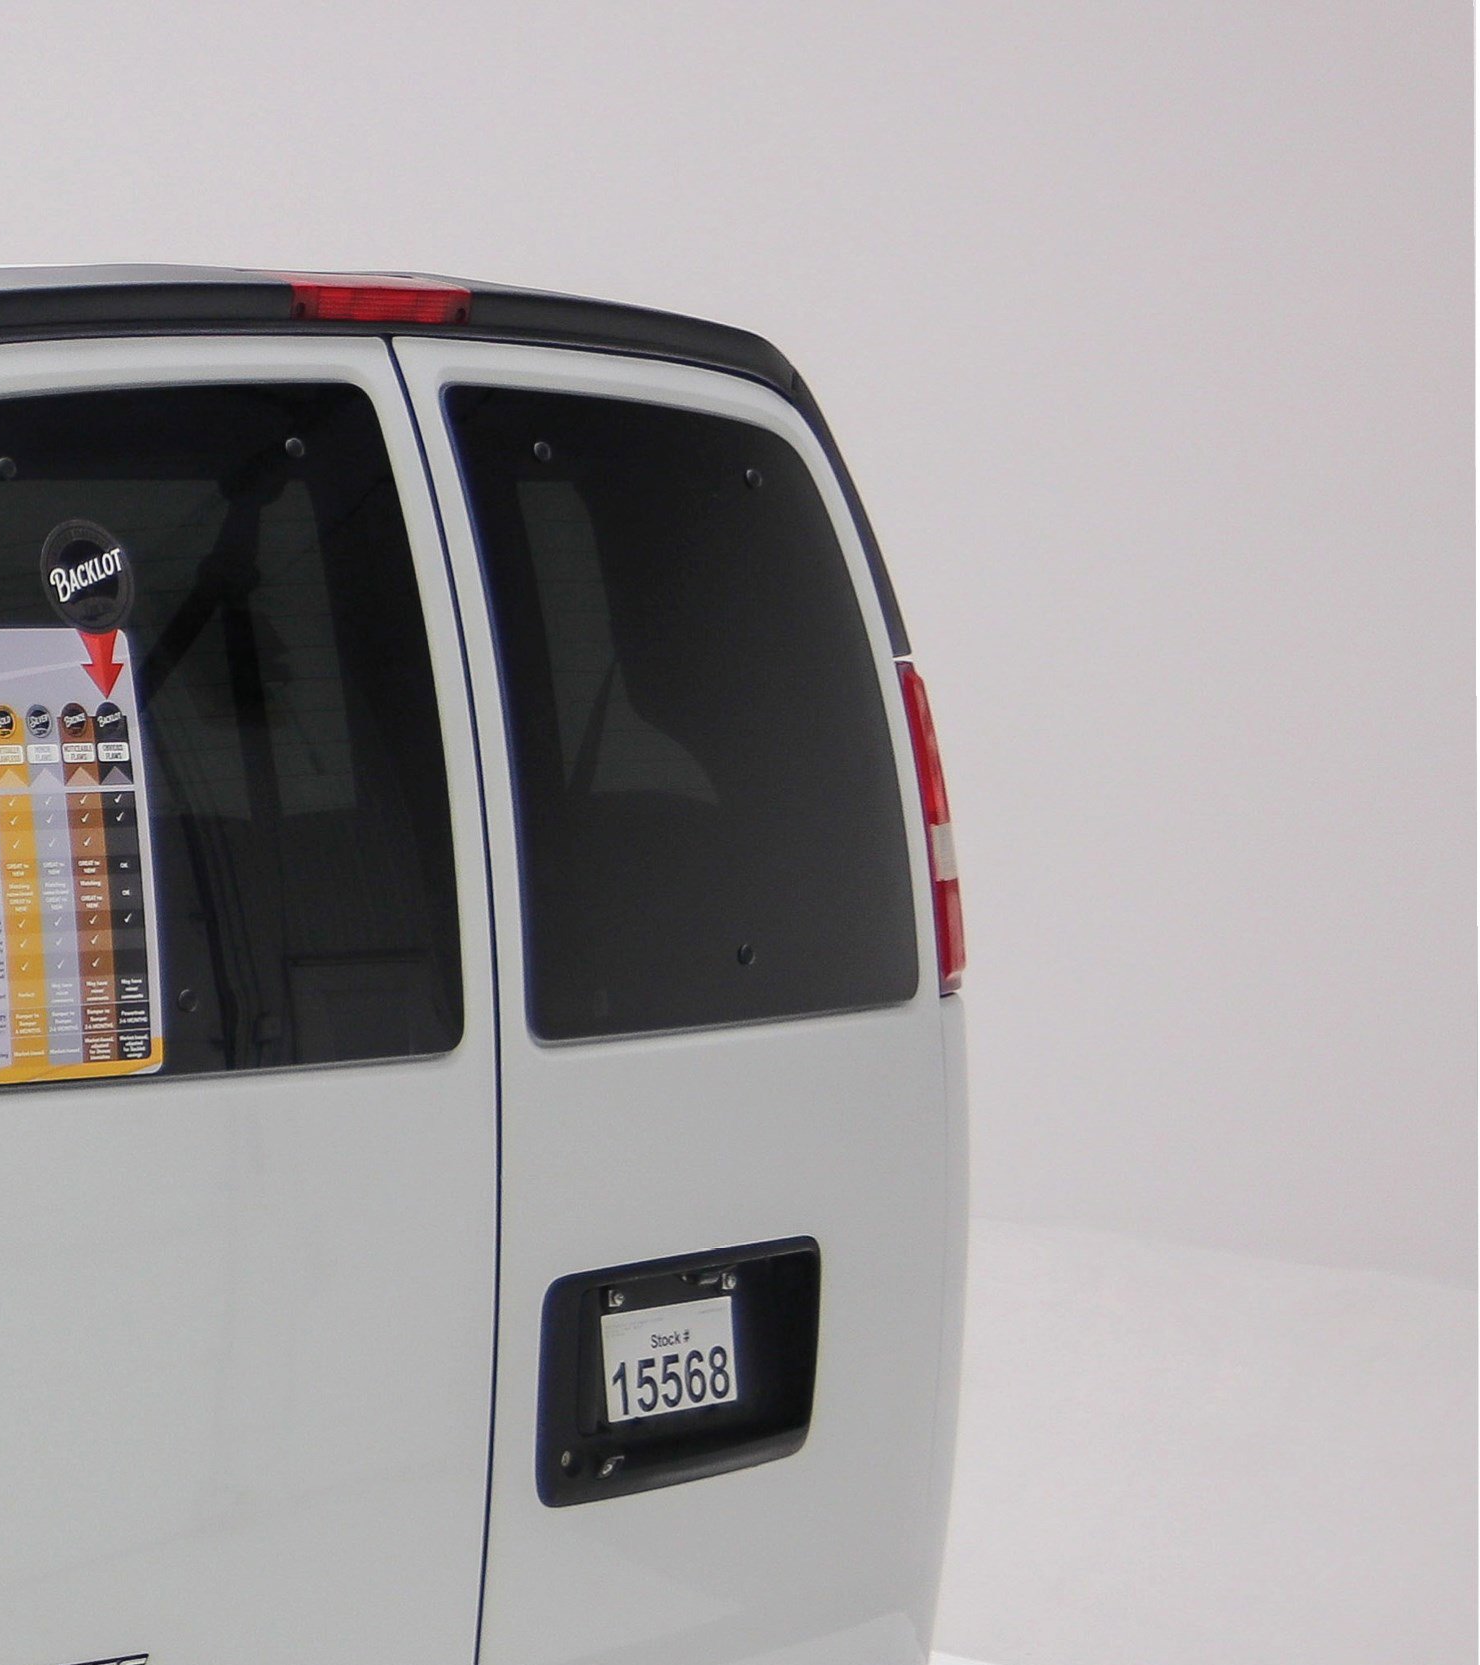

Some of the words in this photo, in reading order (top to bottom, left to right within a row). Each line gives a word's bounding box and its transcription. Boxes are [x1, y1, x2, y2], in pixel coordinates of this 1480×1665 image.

[49, 547, 122, 603] BACKLOT
[650, 1330, 682, 1349] Stock
[682, 1329, 691, 1344] #
[612, 1345, 730, 1416] 15568
